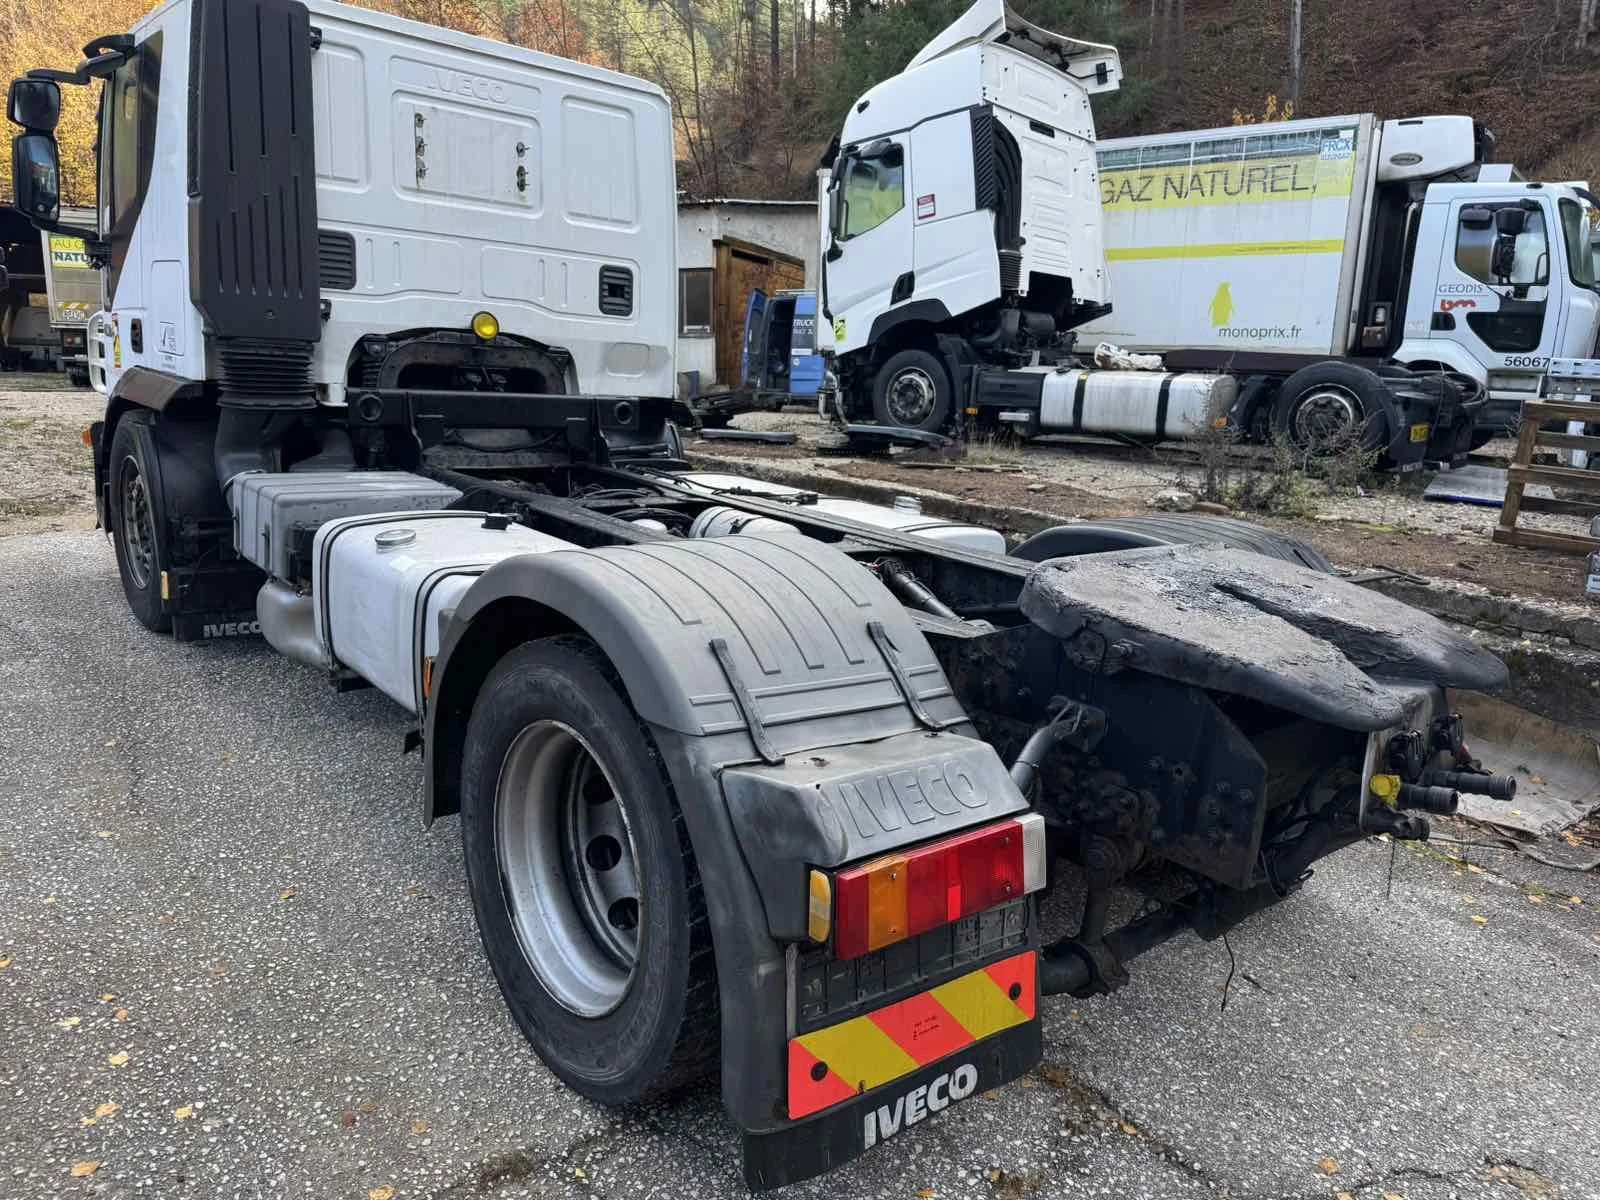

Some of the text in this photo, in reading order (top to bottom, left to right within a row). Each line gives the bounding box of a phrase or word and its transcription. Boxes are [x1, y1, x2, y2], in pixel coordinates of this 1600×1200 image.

[427, 68, 513, 104] IVECO
[1100, 163, 1317, 205] GAZ NATUREL,
[54, 240, 71, 249] AU
[55, 253, 89, 262] NATU
[1438, 282, 1484, 294] GEODIS
[1218, 325, 1302, 341] monoprix.fr
[1504, 356, 1550, 368] 56067
[203, 621, 262, 637] IVECO
[838, 760, 988, 839] IVECO
[864, 1063, 978, 1151] IVECO
